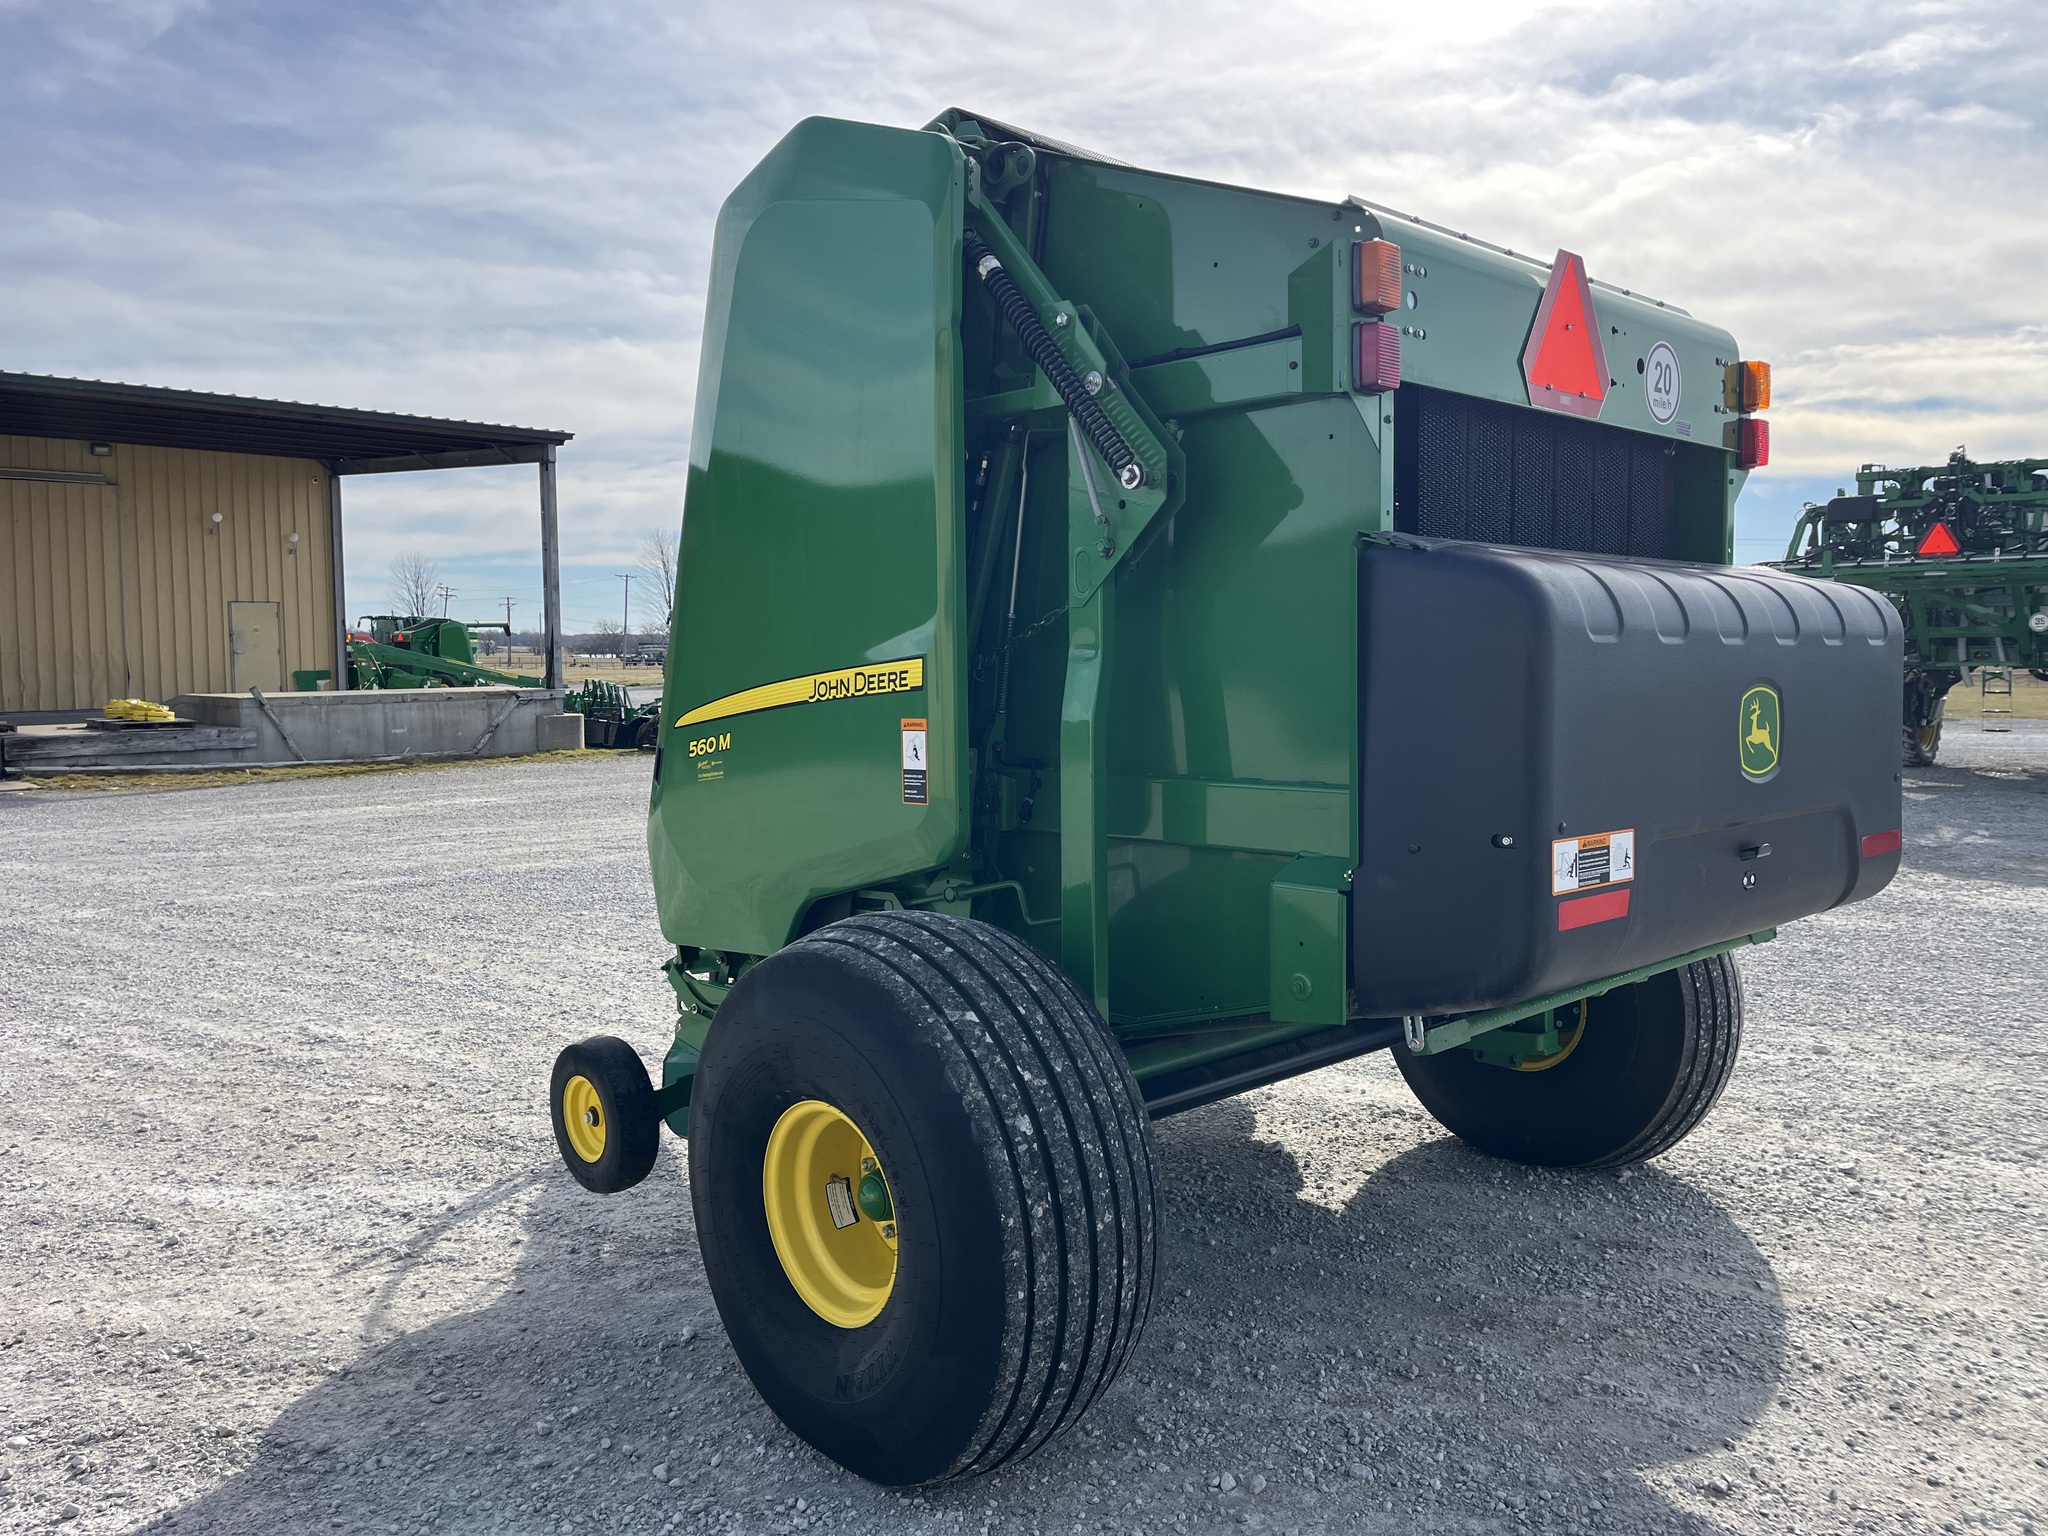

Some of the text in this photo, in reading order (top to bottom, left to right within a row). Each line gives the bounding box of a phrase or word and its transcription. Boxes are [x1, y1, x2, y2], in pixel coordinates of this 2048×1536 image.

[1653, 361, 1672, 395] 20
[2034, 617, 2046, 625] 35
[808, 670, 909, 700] JOHN DEERE
[689, 731, 731, 758] 560 M
[1586, 838, 1607, 847] WARNING
[834, 1340, 899, 1397] TITAN
